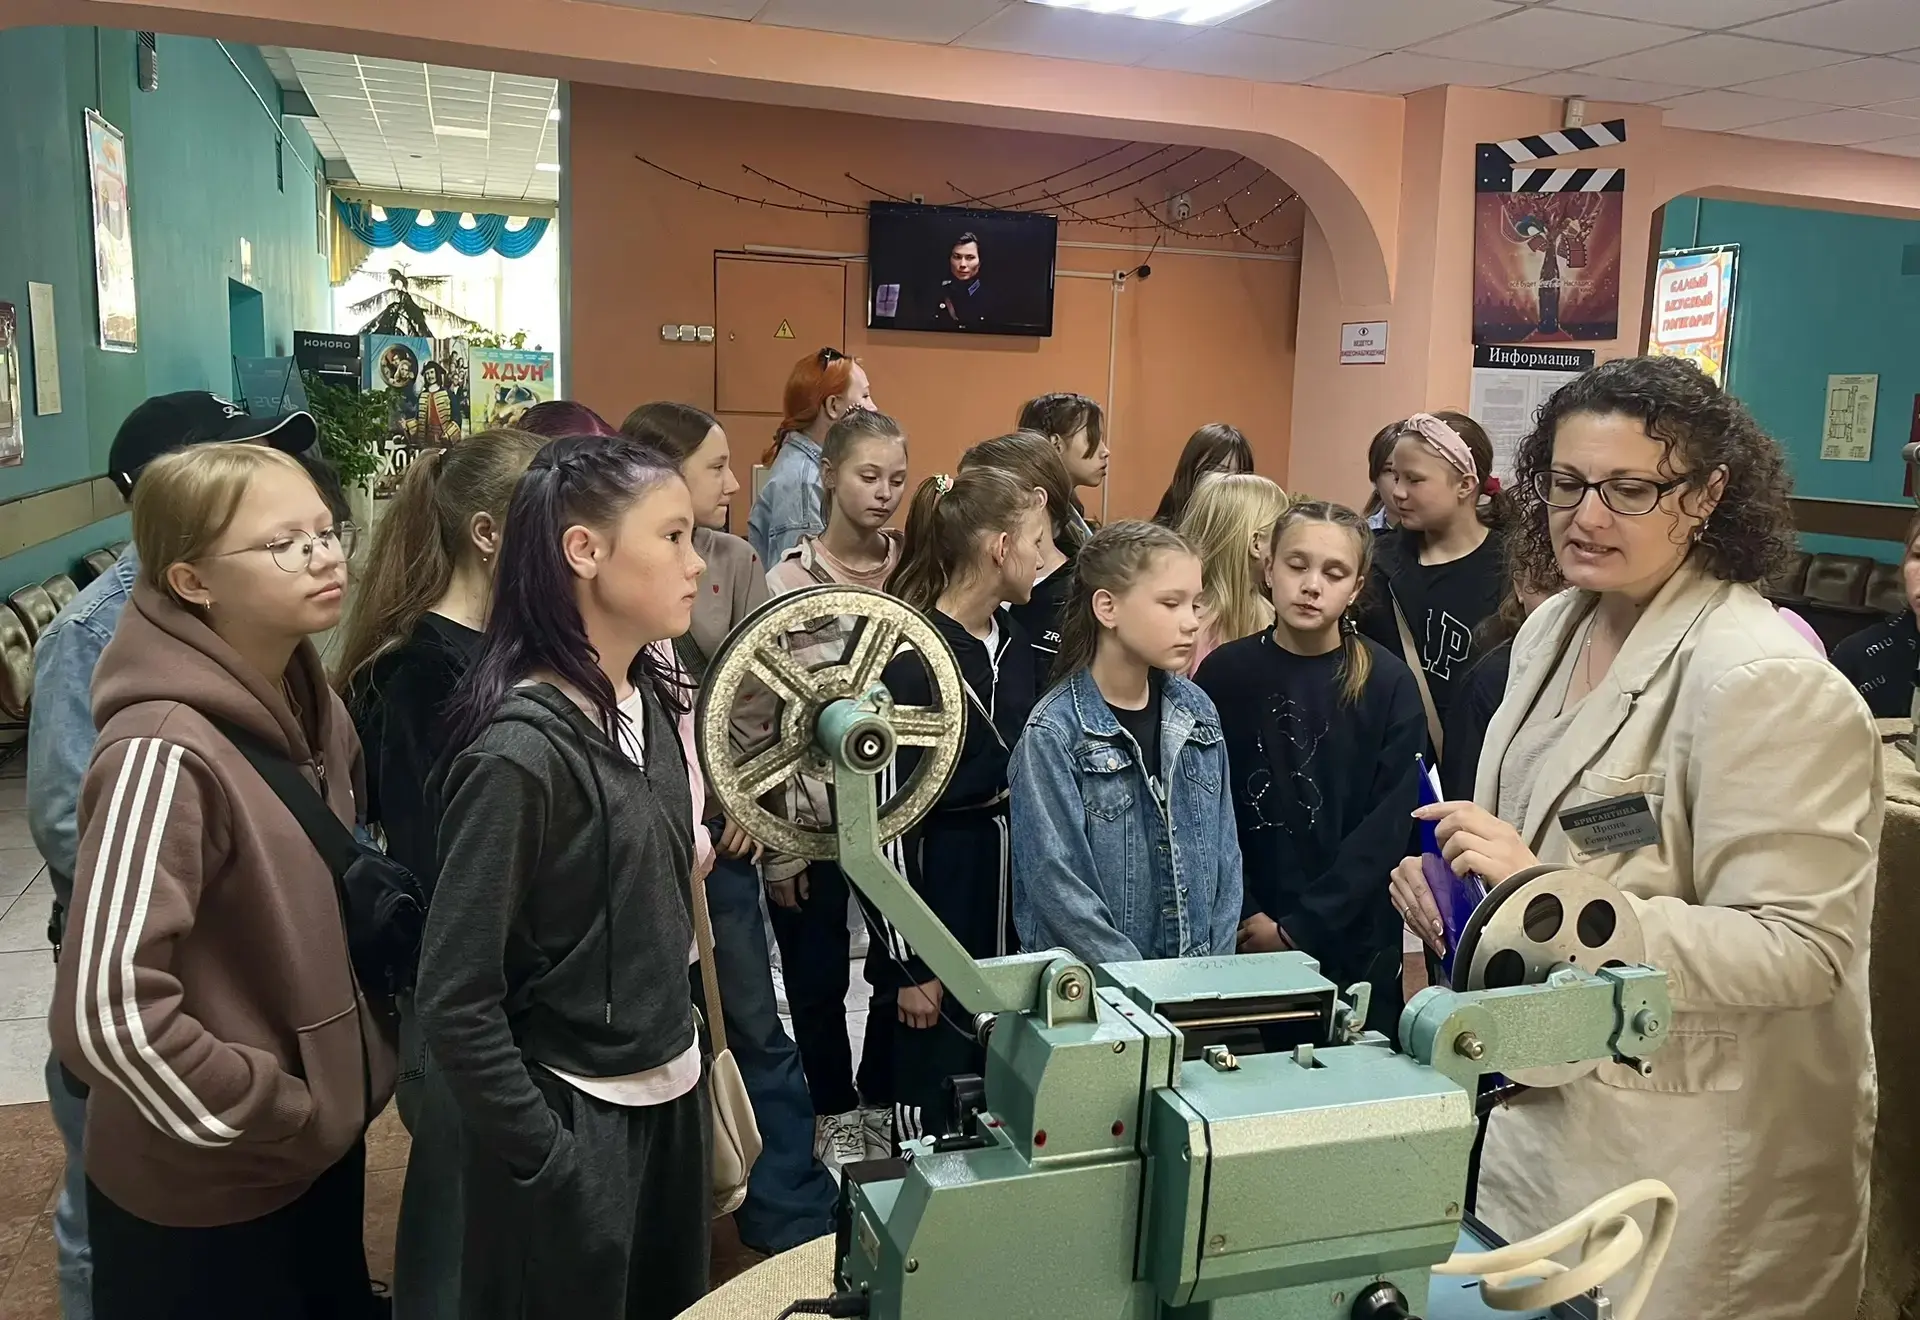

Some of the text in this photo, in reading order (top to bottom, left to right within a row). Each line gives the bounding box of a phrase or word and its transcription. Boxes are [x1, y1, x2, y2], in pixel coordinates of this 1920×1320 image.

[1489, 347, 1580, 367] Информация
[482, 362, 544, 382] ЖДУН
[1042, 630, 1062, 643] ZR
[1573, 806, 1637, 827] БРИГАНТИНА
